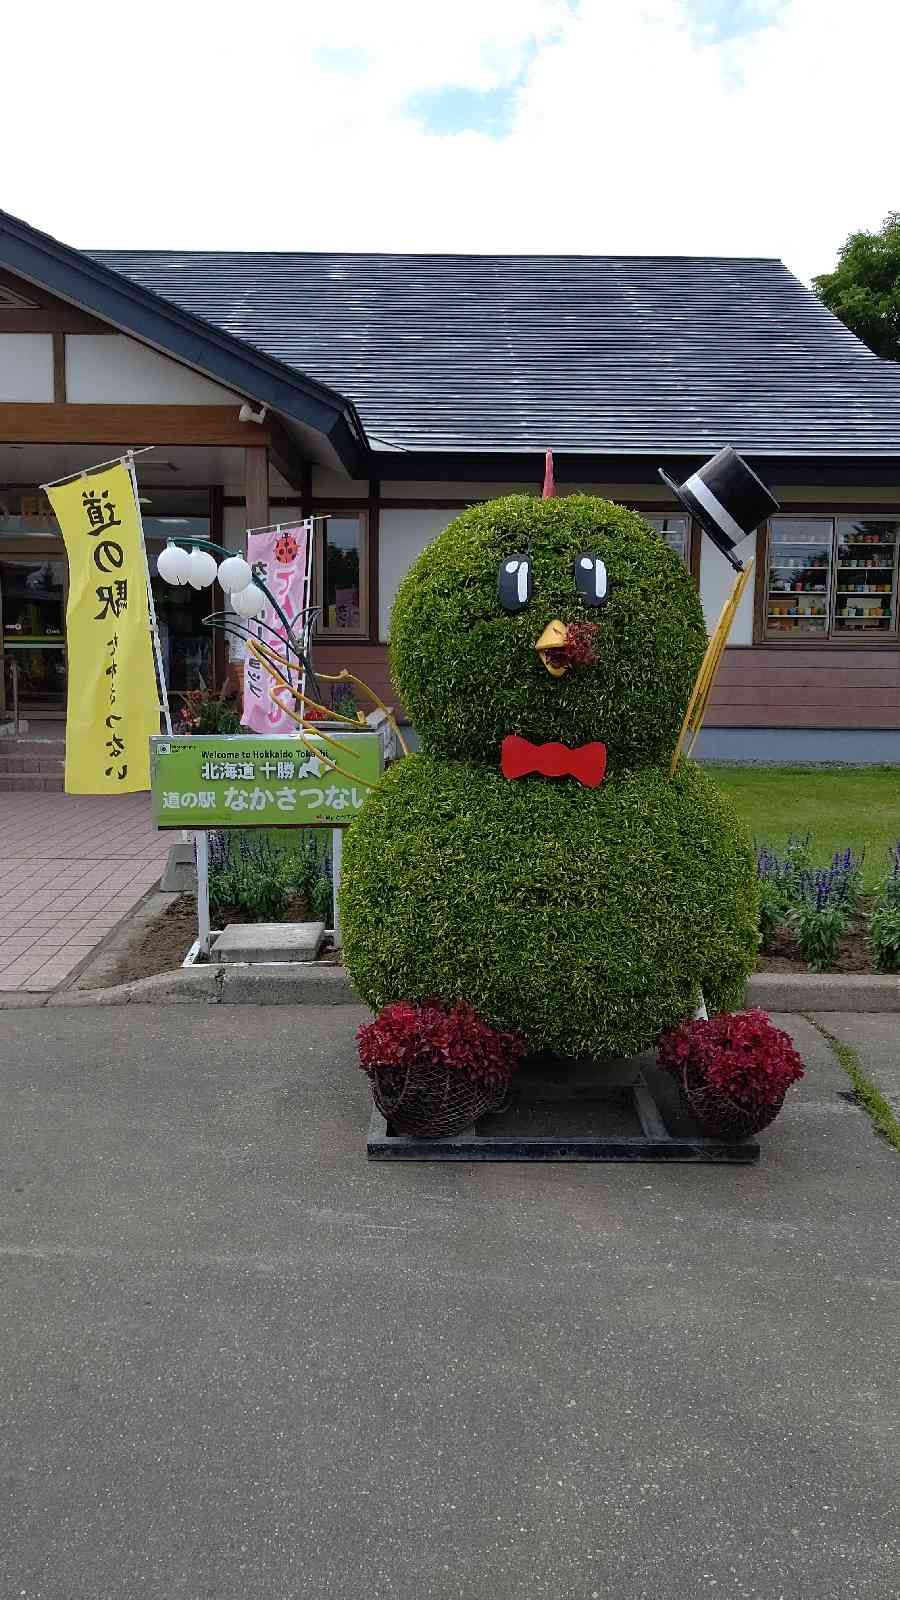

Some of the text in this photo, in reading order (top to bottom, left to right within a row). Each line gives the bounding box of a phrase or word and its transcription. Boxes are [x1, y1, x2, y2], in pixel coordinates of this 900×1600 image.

[201, 751, 242, 759] Welcome
[253, 750, 293, 759] Hokkaido
[201, 761, 295, 780] 北海道 十勝
[162, 791, 217, 809] 道の駅
